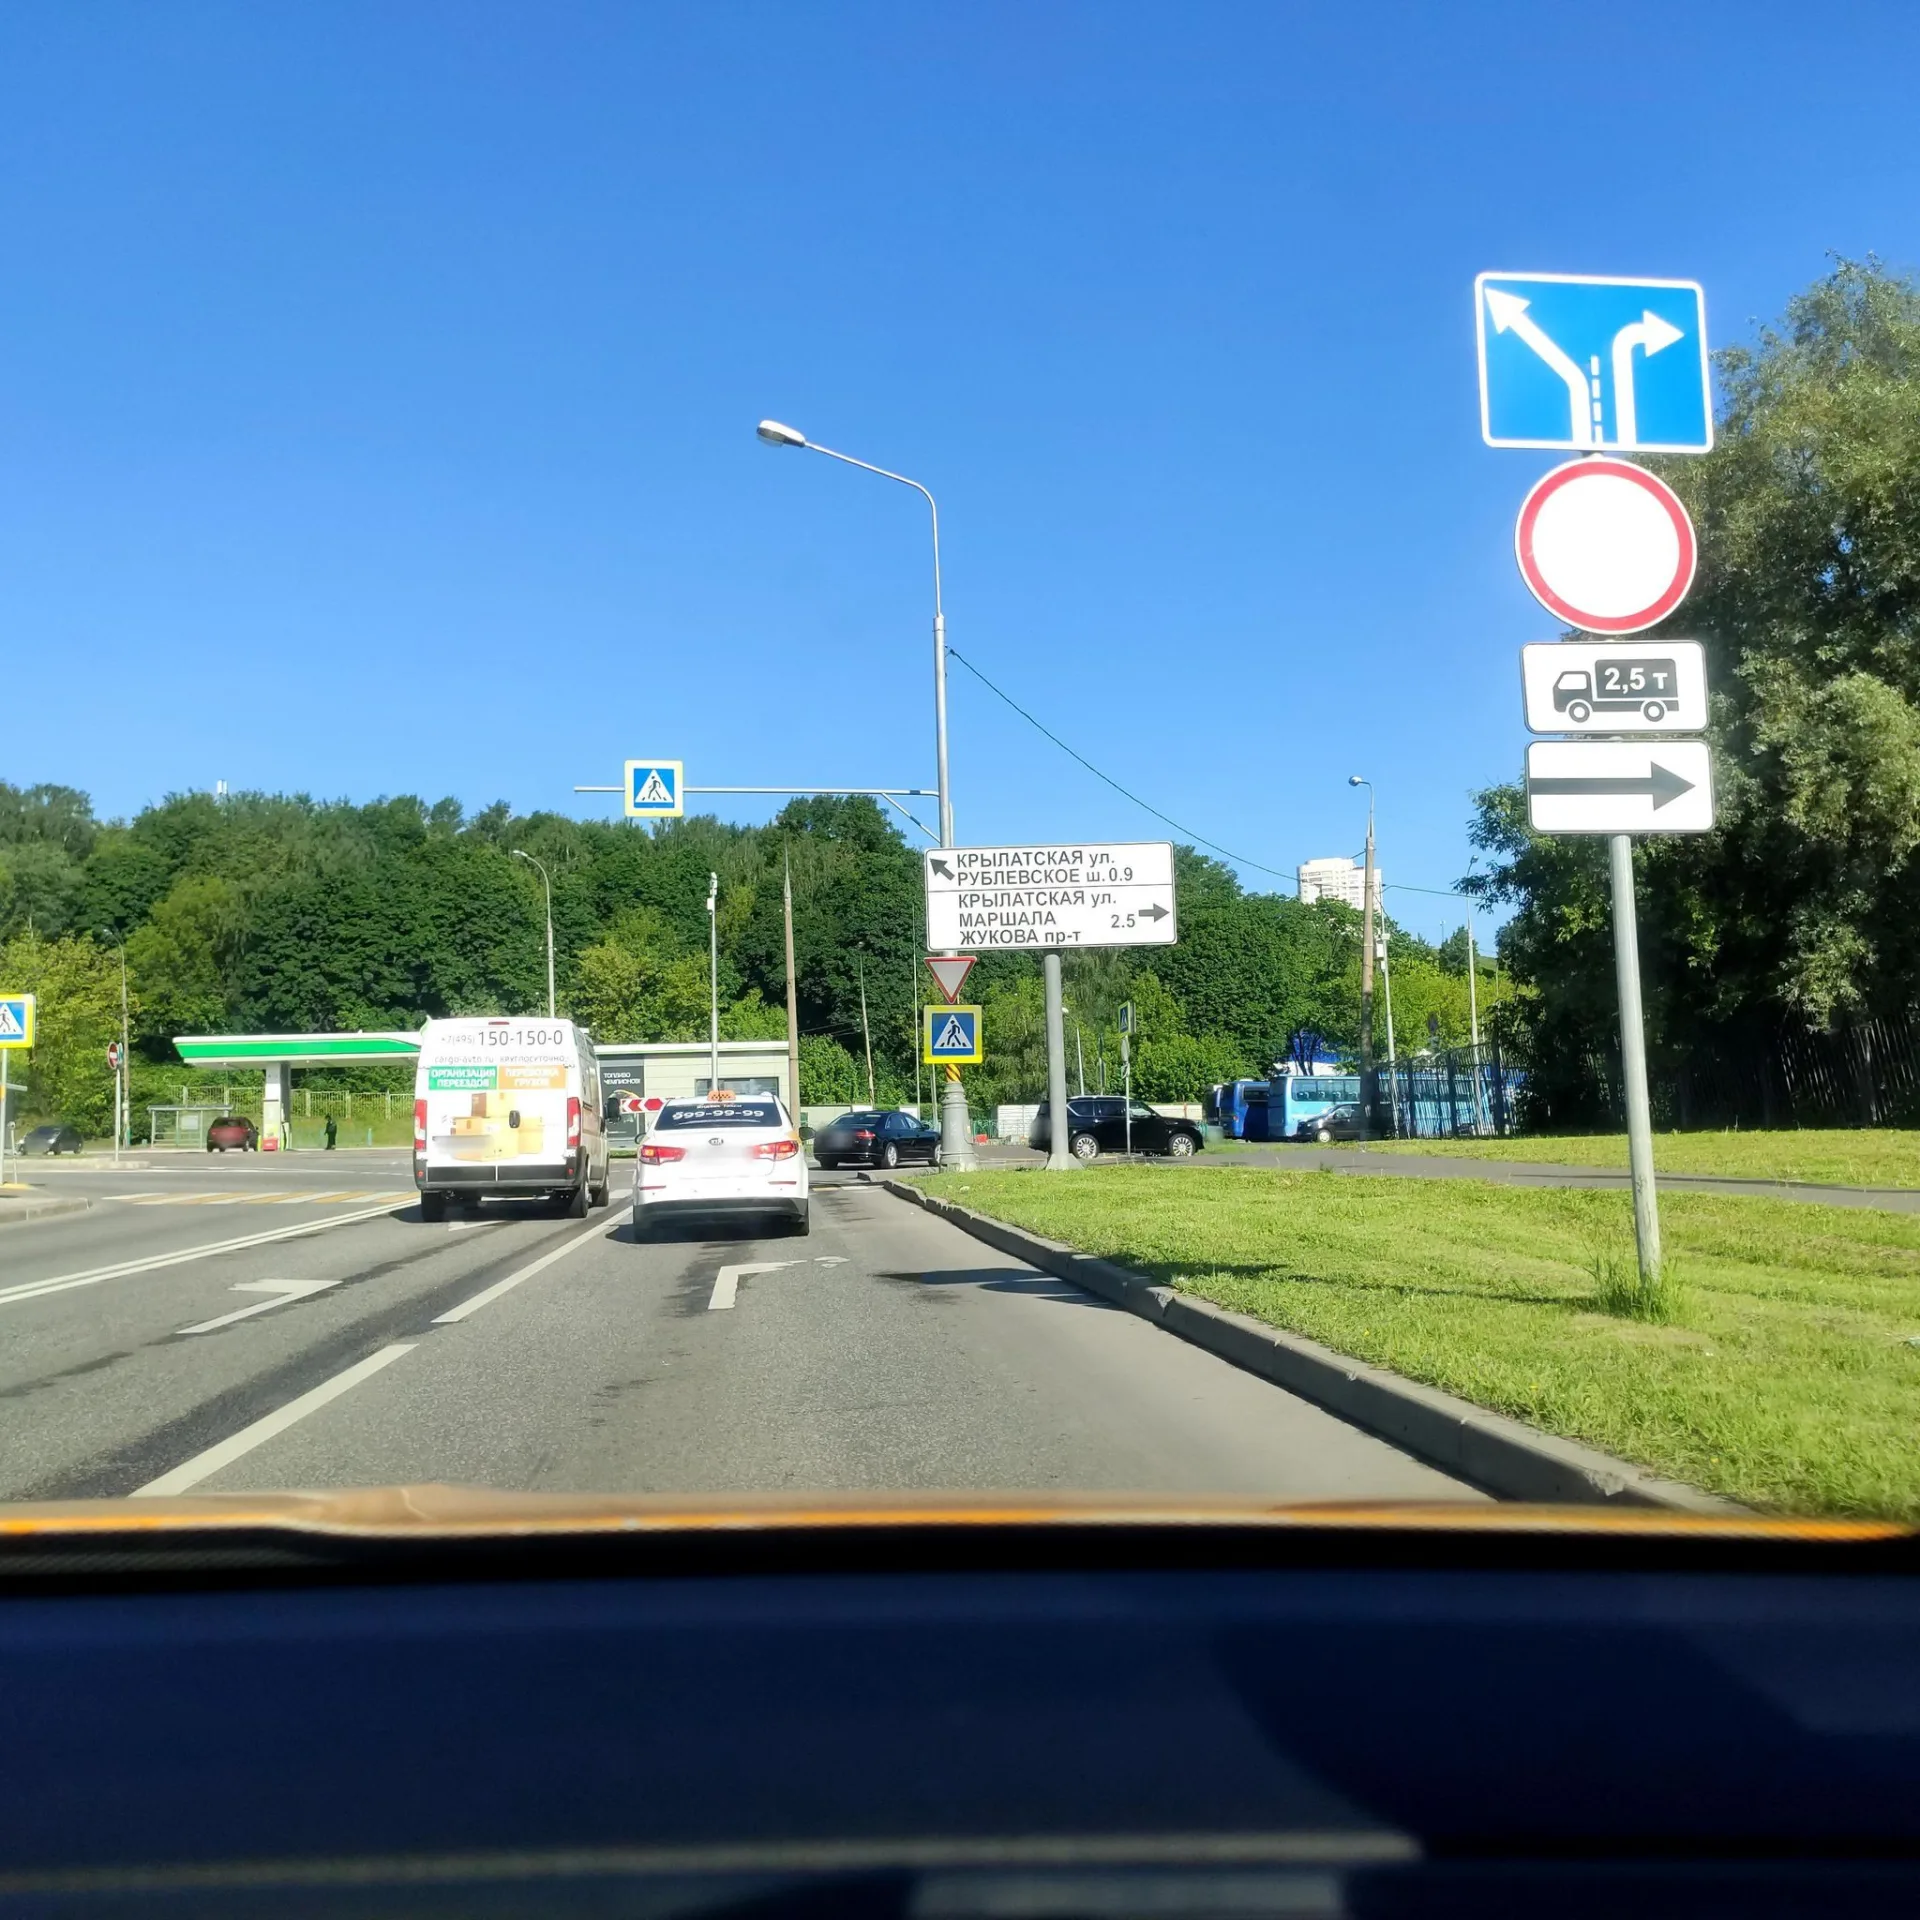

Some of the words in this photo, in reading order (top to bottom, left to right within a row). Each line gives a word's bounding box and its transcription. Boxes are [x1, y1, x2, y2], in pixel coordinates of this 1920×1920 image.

[1604, 667, 1646, 694] 2,5
[957, 851, 1083, 868] КРЫЛАТСКАЯ
[1089, 853, 1115, 867] ул.
[957, 869, 1080, 886] РУБЛЕВСКОЕ
[1086, 871, 1105, 882] ш.
[1109, 867, 1133, 882] 0.9
[958, 891, 1085, 908] КРЫЛАТСКАЯ
[1091, 893, 1117, 908] ул.
[959, 911, 1056, 927] МАРШАЛА
[1111, 914, 1136, 928] 2.5
[960, 929, 1039, 945] ЖУКОВА
[1044, 931, 1081, 944] пр-т
[477, 1030, 563, 1046] 150-150-0
